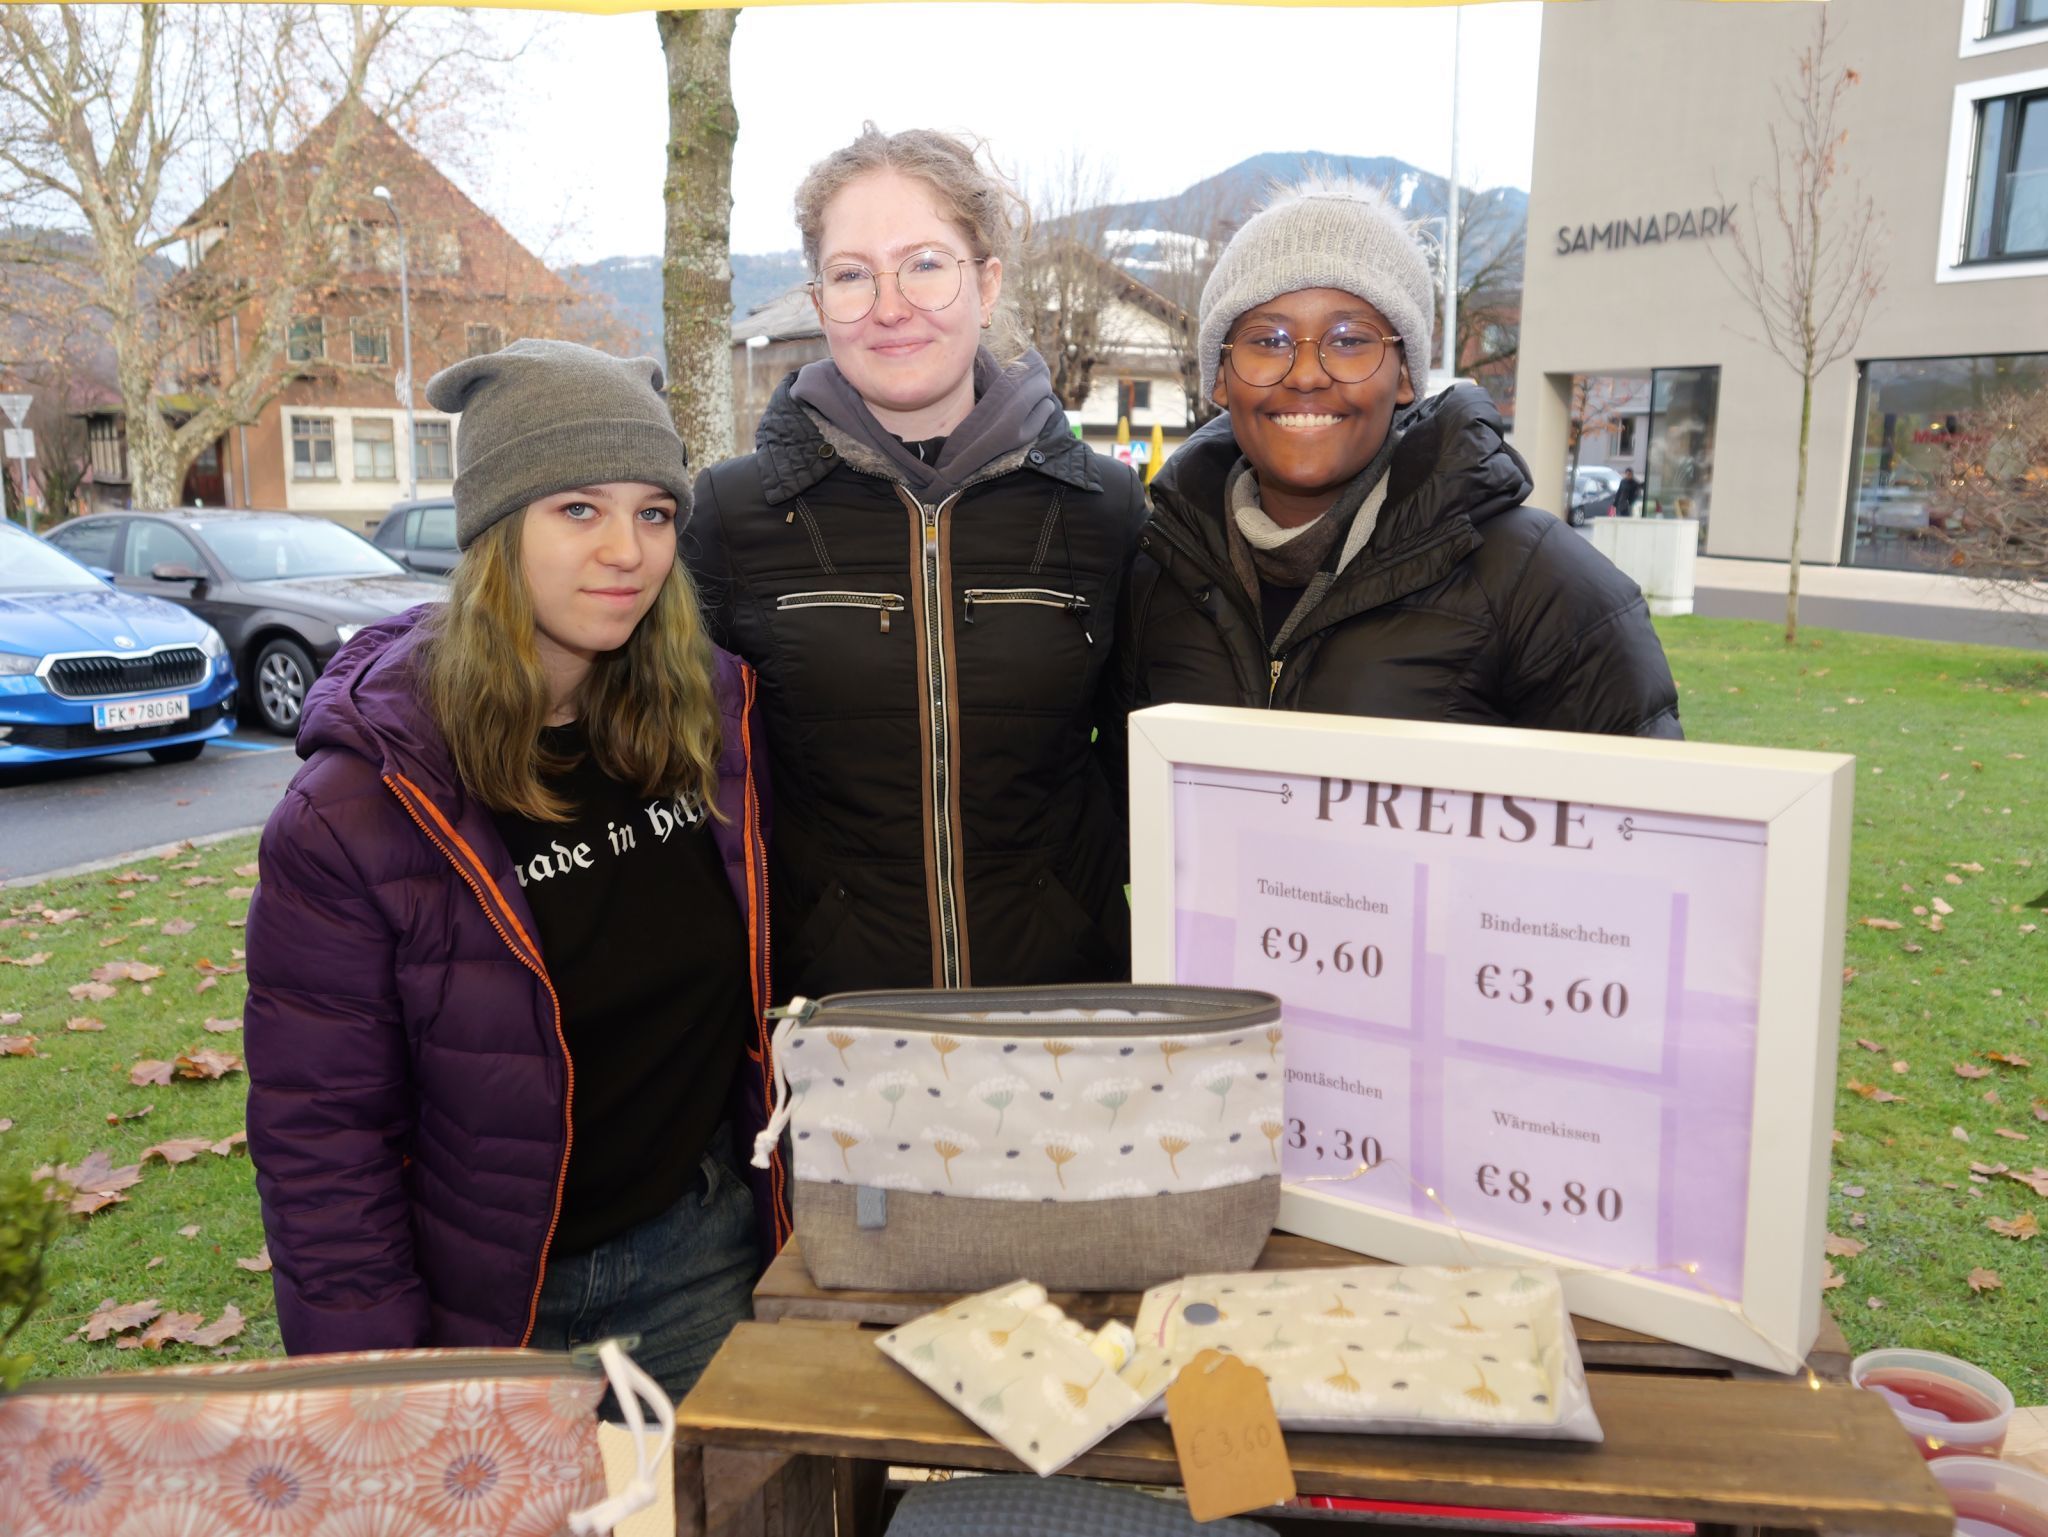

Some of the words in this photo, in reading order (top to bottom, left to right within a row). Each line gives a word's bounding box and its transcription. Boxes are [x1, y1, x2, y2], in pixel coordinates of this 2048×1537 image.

[1556, 203, 1737, 256] SAMINAPARK
[108, 707, 127, 722] FK
[137, 702, 164, 719] 780
[1315, 776, 1593, 850] PREISE
[608, 821, 636, 856] in
[1257, 878, 1389, 914] Toilettentäschchen
[1480, 912, 1631, 948] Bindentäschchen
[1260, 927, 1384, 978] €9,60
[1475, 963, 1629, 1019] €3,60
[1284, 1068, 1383, 1099] pontäschchen
[1288, 1118, 1382, 1168] 3,30
[1492, 1110, 1601, 1144] Wärmekissen
[1475, 1163, 1623, 1222] €8,80
